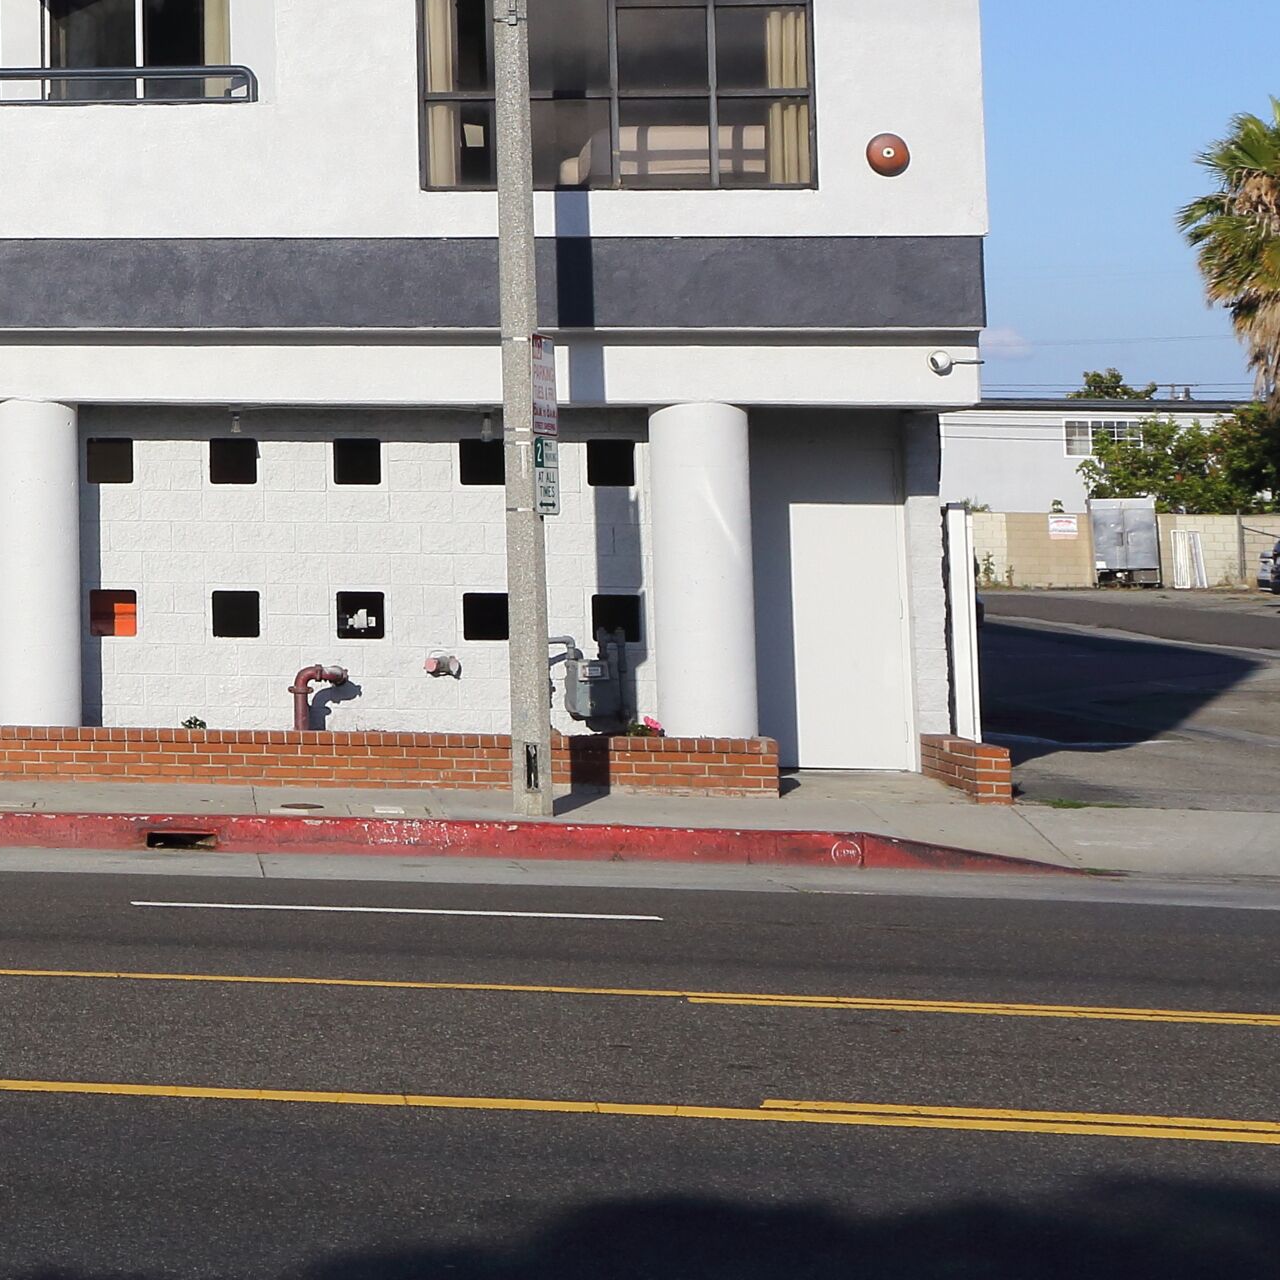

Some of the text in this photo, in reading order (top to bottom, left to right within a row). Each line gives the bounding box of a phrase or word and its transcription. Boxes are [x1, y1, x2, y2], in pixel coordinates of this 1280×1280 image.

[537, 443, 542, 461] 2
[538, 471, 556, 483] AT ALL
[540, 486, 555, 498] TIMES
